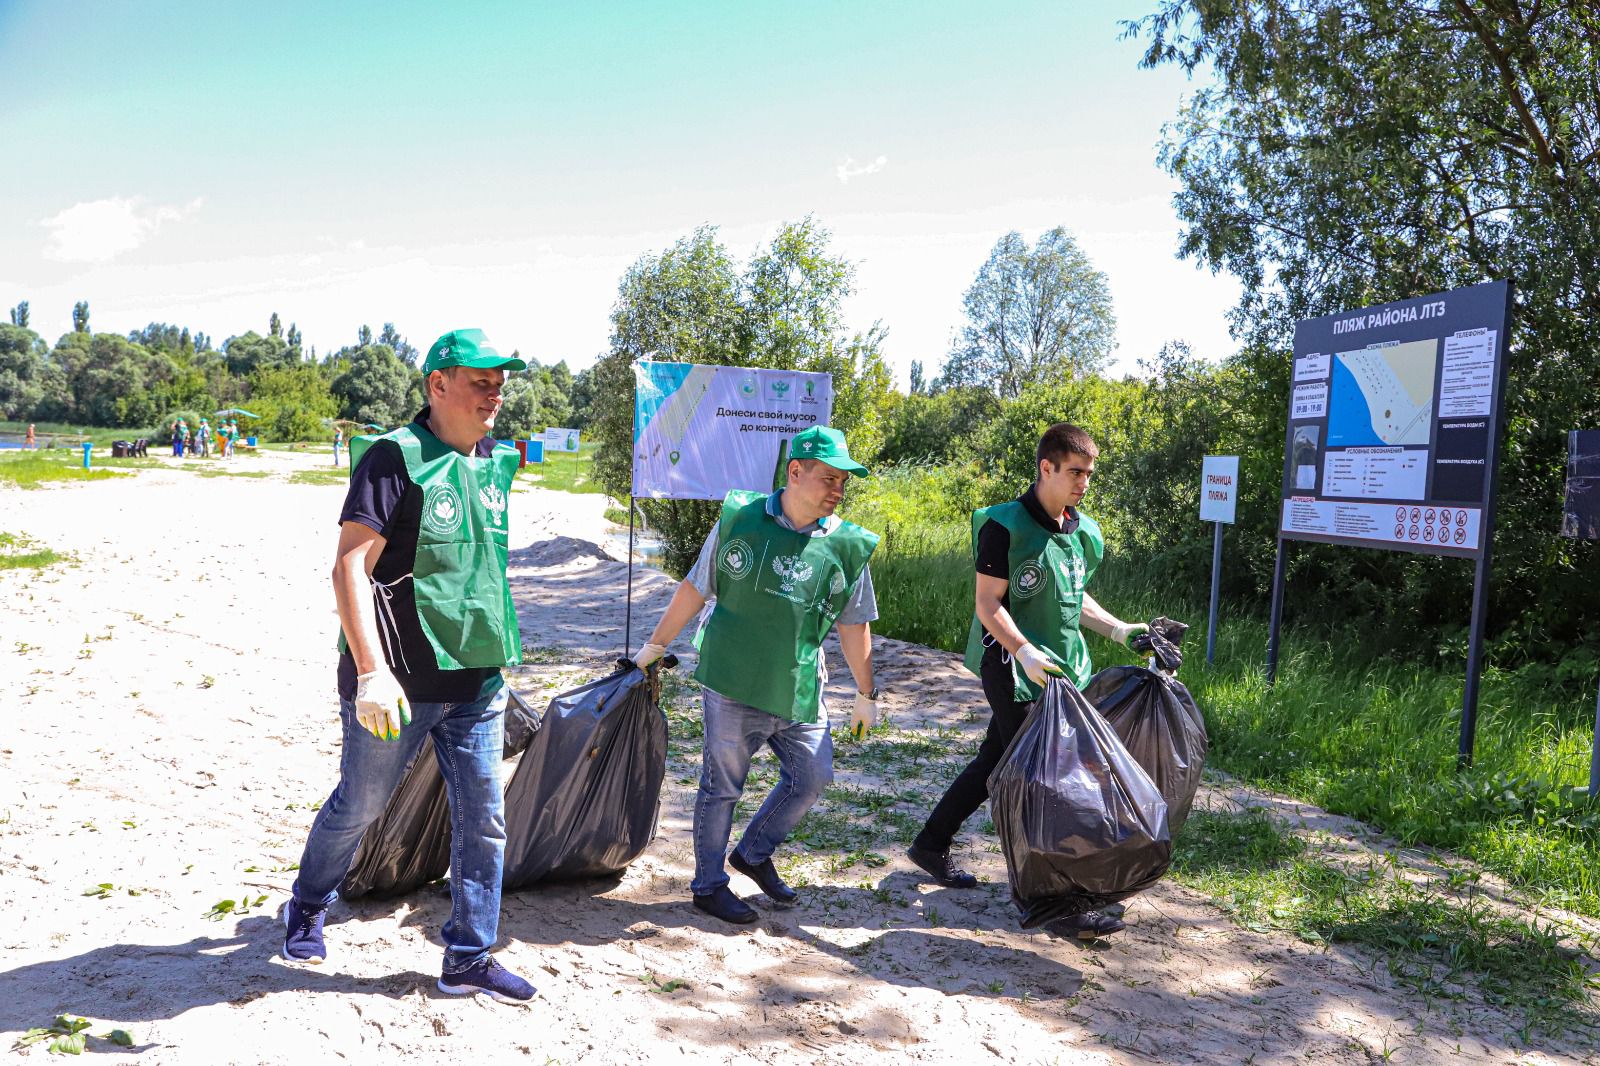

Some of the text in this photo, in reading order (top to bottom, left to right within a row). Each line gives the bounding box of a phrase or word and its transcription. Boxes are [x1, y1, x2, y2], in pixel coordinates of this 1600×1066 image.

[1333, 301, 1446, 335] ПЛЯЖ РАЙОНА ЛТЗ
[1456, 329, 1486, 339] ТЕЛЕФОНЫ
[716, 407, 817, 423] Донеси свой мусор
[740, 424, 754, 432] до
[1207, 474, 1232, 487] ГРАНИЦА
[1208, 490, 1228, 502] ПЛЯЖА
